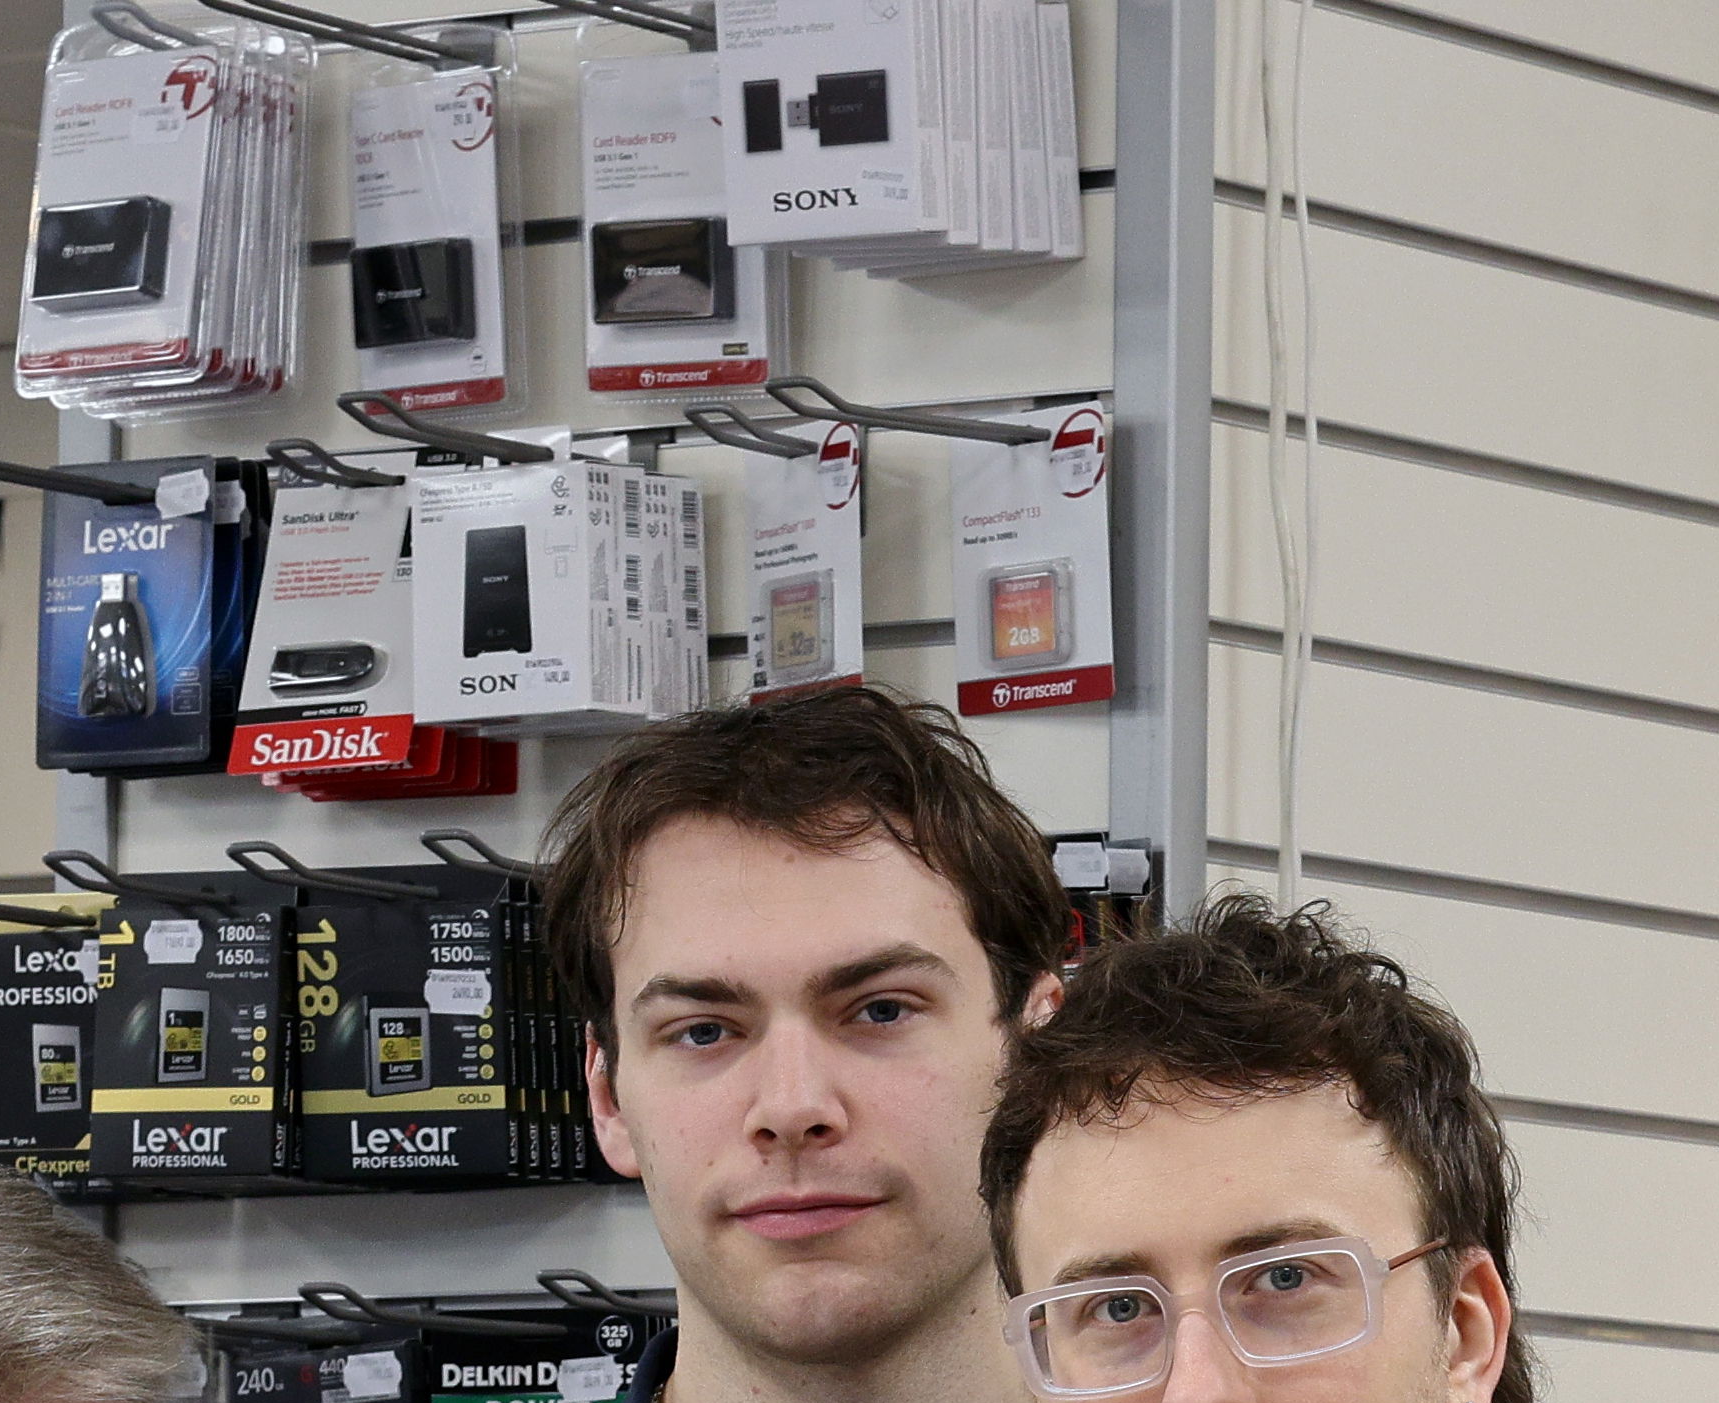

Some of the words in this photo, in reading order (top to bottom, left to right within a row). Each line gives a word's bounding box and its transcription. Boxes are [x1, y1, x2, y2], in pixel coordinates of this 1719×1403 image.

[773, 187, 859, 212] SONY
[657, 371, 709, 383] Transcend
[282, 513, 325, 525] SanDisk
[962, 508, 1021, 528] CompactFlash
[1027, 506, 1042, 519] 133
[83, 520, 173, 555] Lexar
[482, 575, 509, 584] SONY
[1009, 627, 1041, 647] 2GB
[460, 674, 520, 696] SON
[1012, 678, 1074, 702] Transcend
[251, 726, 383, 767] SanDisk
[217, 925, 255, 941] 1800
[430, 922, 473, 939] 1750
[14, 944, 83, 973] Lexa
[216, 949, 254, 965] 1650
[431, 946, 473, 963] 1500
[97, 953, 117, 989] TB
[297, 918, 339, 1017] 128
[299, 1020, 316, 1053] GB
[382, 1022, 404, 1035] 128
[389, 1063, 414, 1073] Lexar
[229, 1094, 261, 1106] GOLD
[457, 1093, 491, 1105] GOLD
[132, 1119, 228, 1154] Lexar
[350, 1120, 458, 1155] Lexar
[132, 1155, 228, 1169] PROFESSIONAL
[351, 1155, 459, 1169] PROFESSIONAL
[601, 1325, 628, 1339] 325
[607, 1338, 622, 1348] GB
[236, 1367, 275, 1396] 240
[442, 1362, 533, 1388] DELKIN
